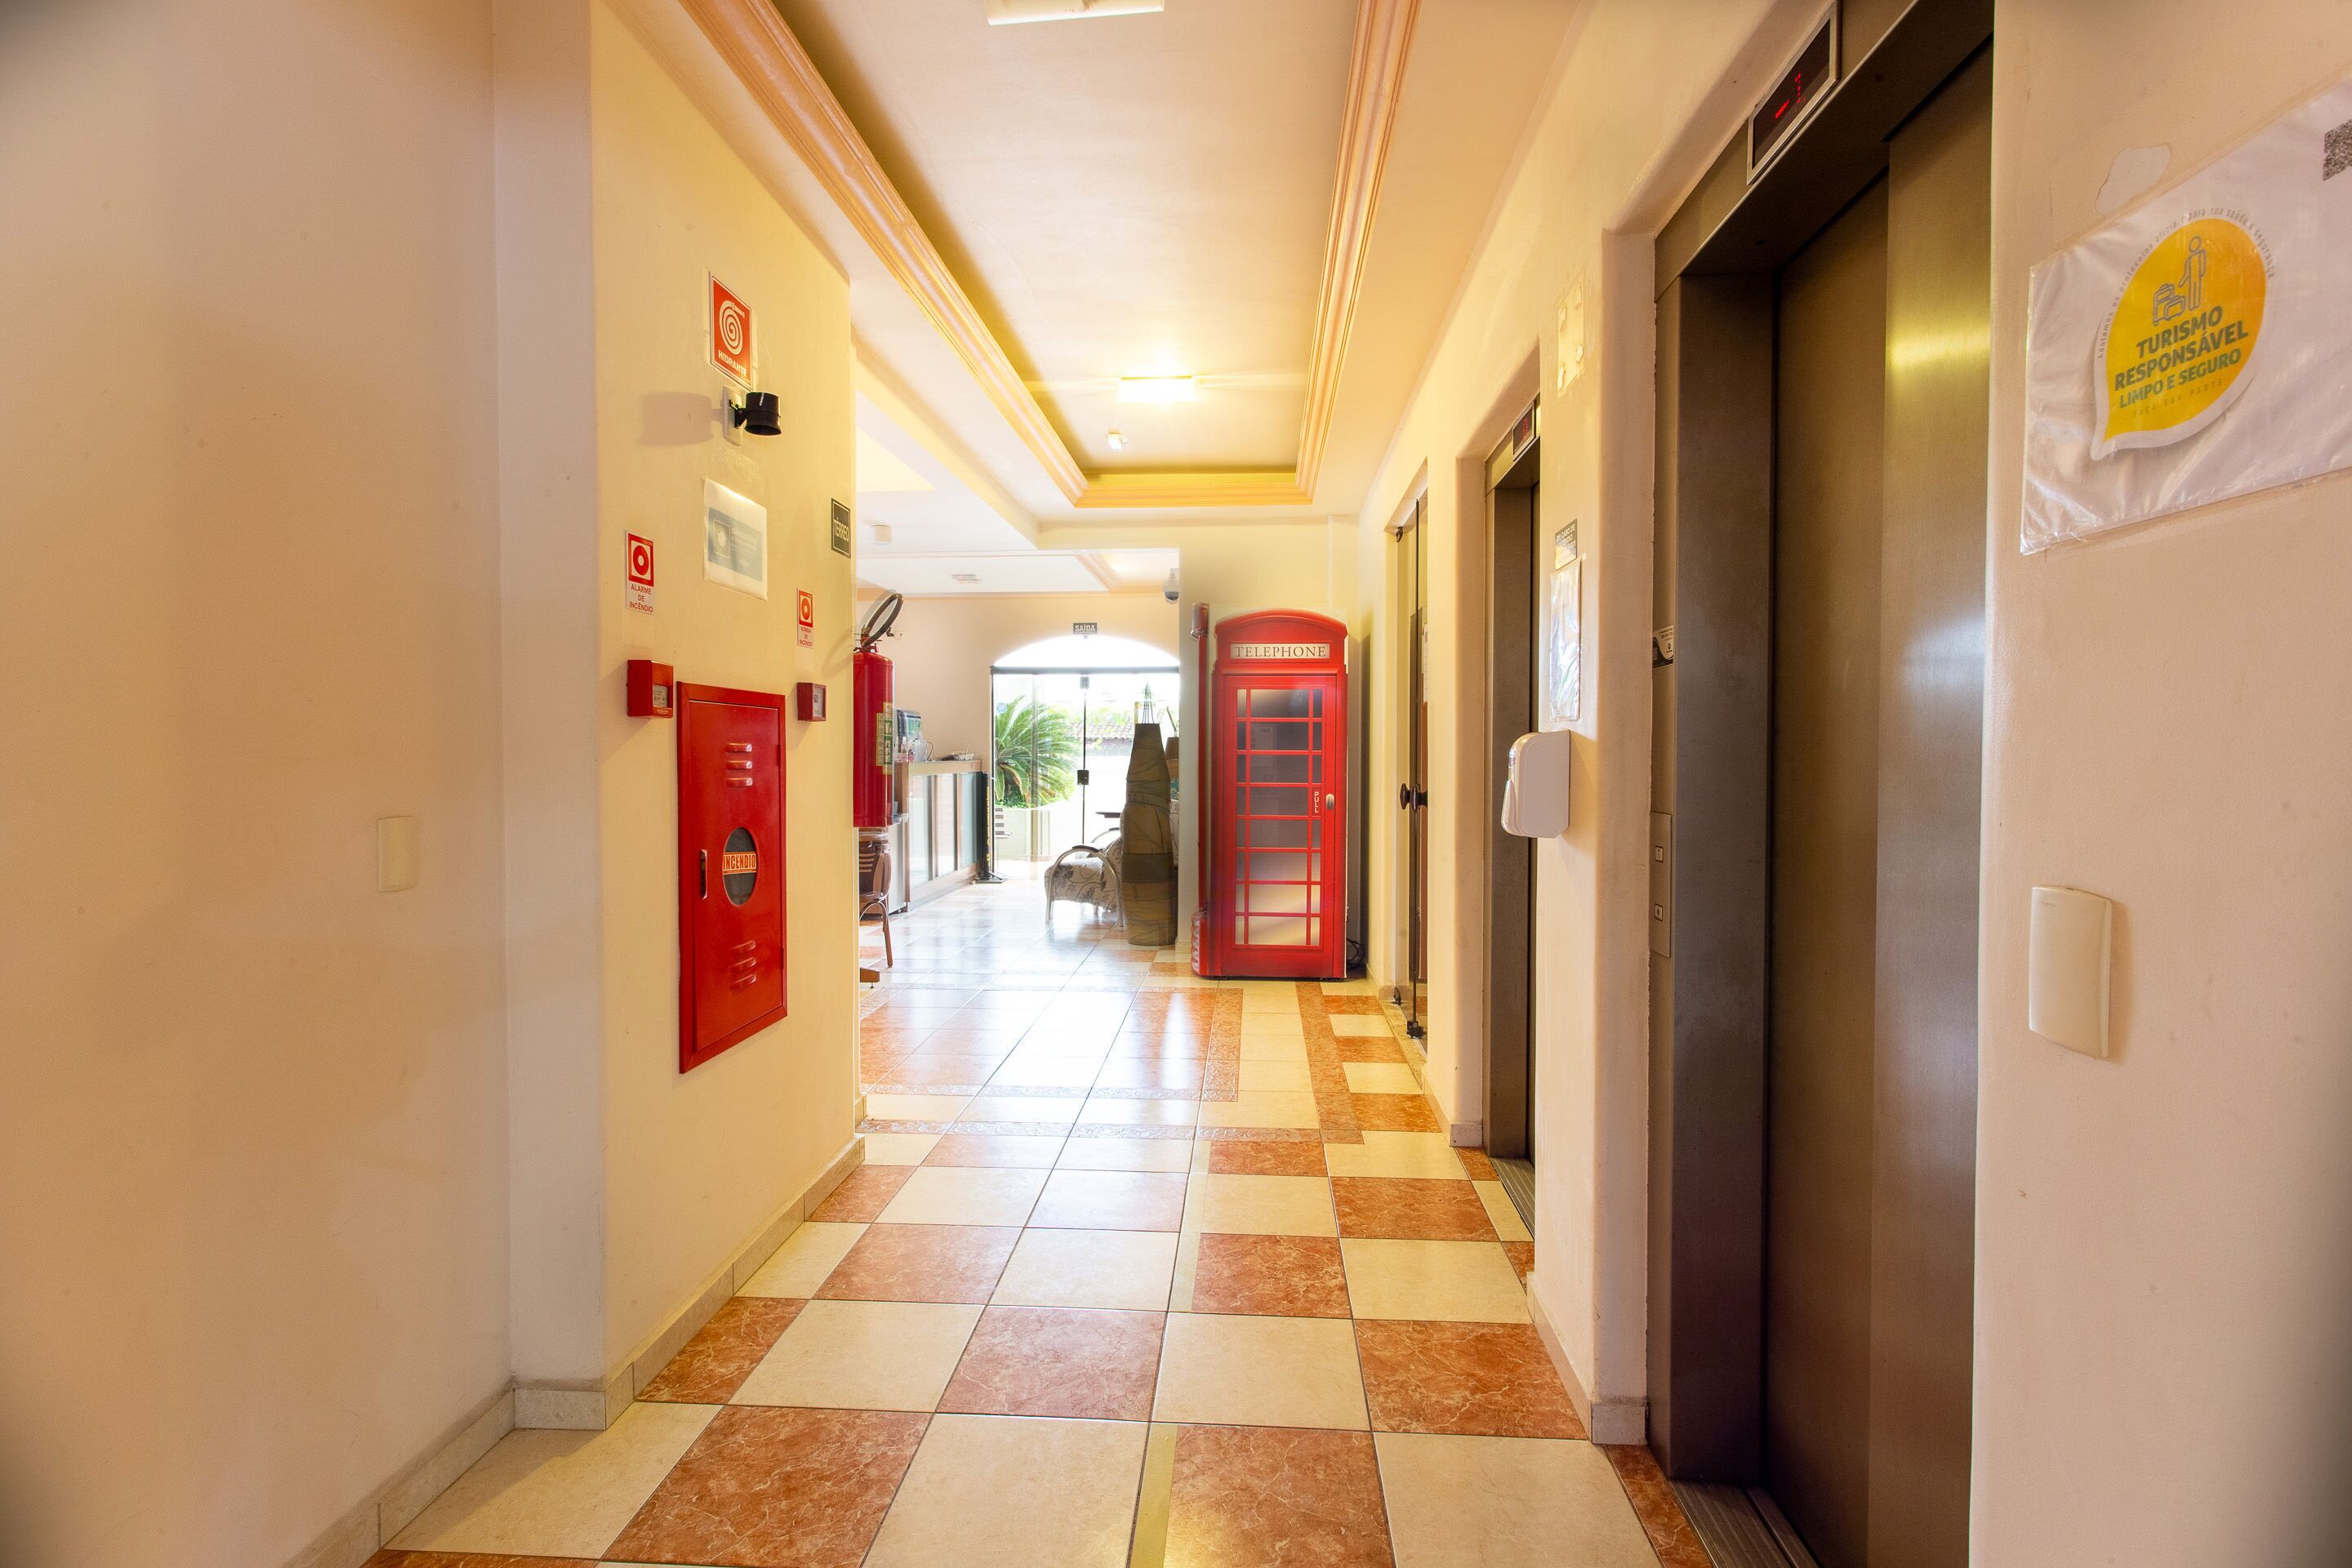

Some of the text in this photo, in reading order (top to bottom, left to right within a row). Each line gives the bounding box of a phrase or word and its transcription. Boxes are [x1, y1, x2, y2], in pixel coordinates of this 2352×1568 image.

[2136, 305, 2223, 359] TURISMO
[718, 349, 747, 377] HIDRANTE
[2114, 319, 2249, 392] RESPONSÁVEL
[2118, 348, 2242, 408] LIMPO E SEGURO
[834, 516, 849, 542] TÉRREO
[630, 584, 652, 595] ALARME
[638, 595, 645, 603] DE
[629, 601, 653, 613] INCÊNDIO
[1075, 623, 1095, 632] SAÍDA
[1234, 646, 1326, 657] TELEPHONE
